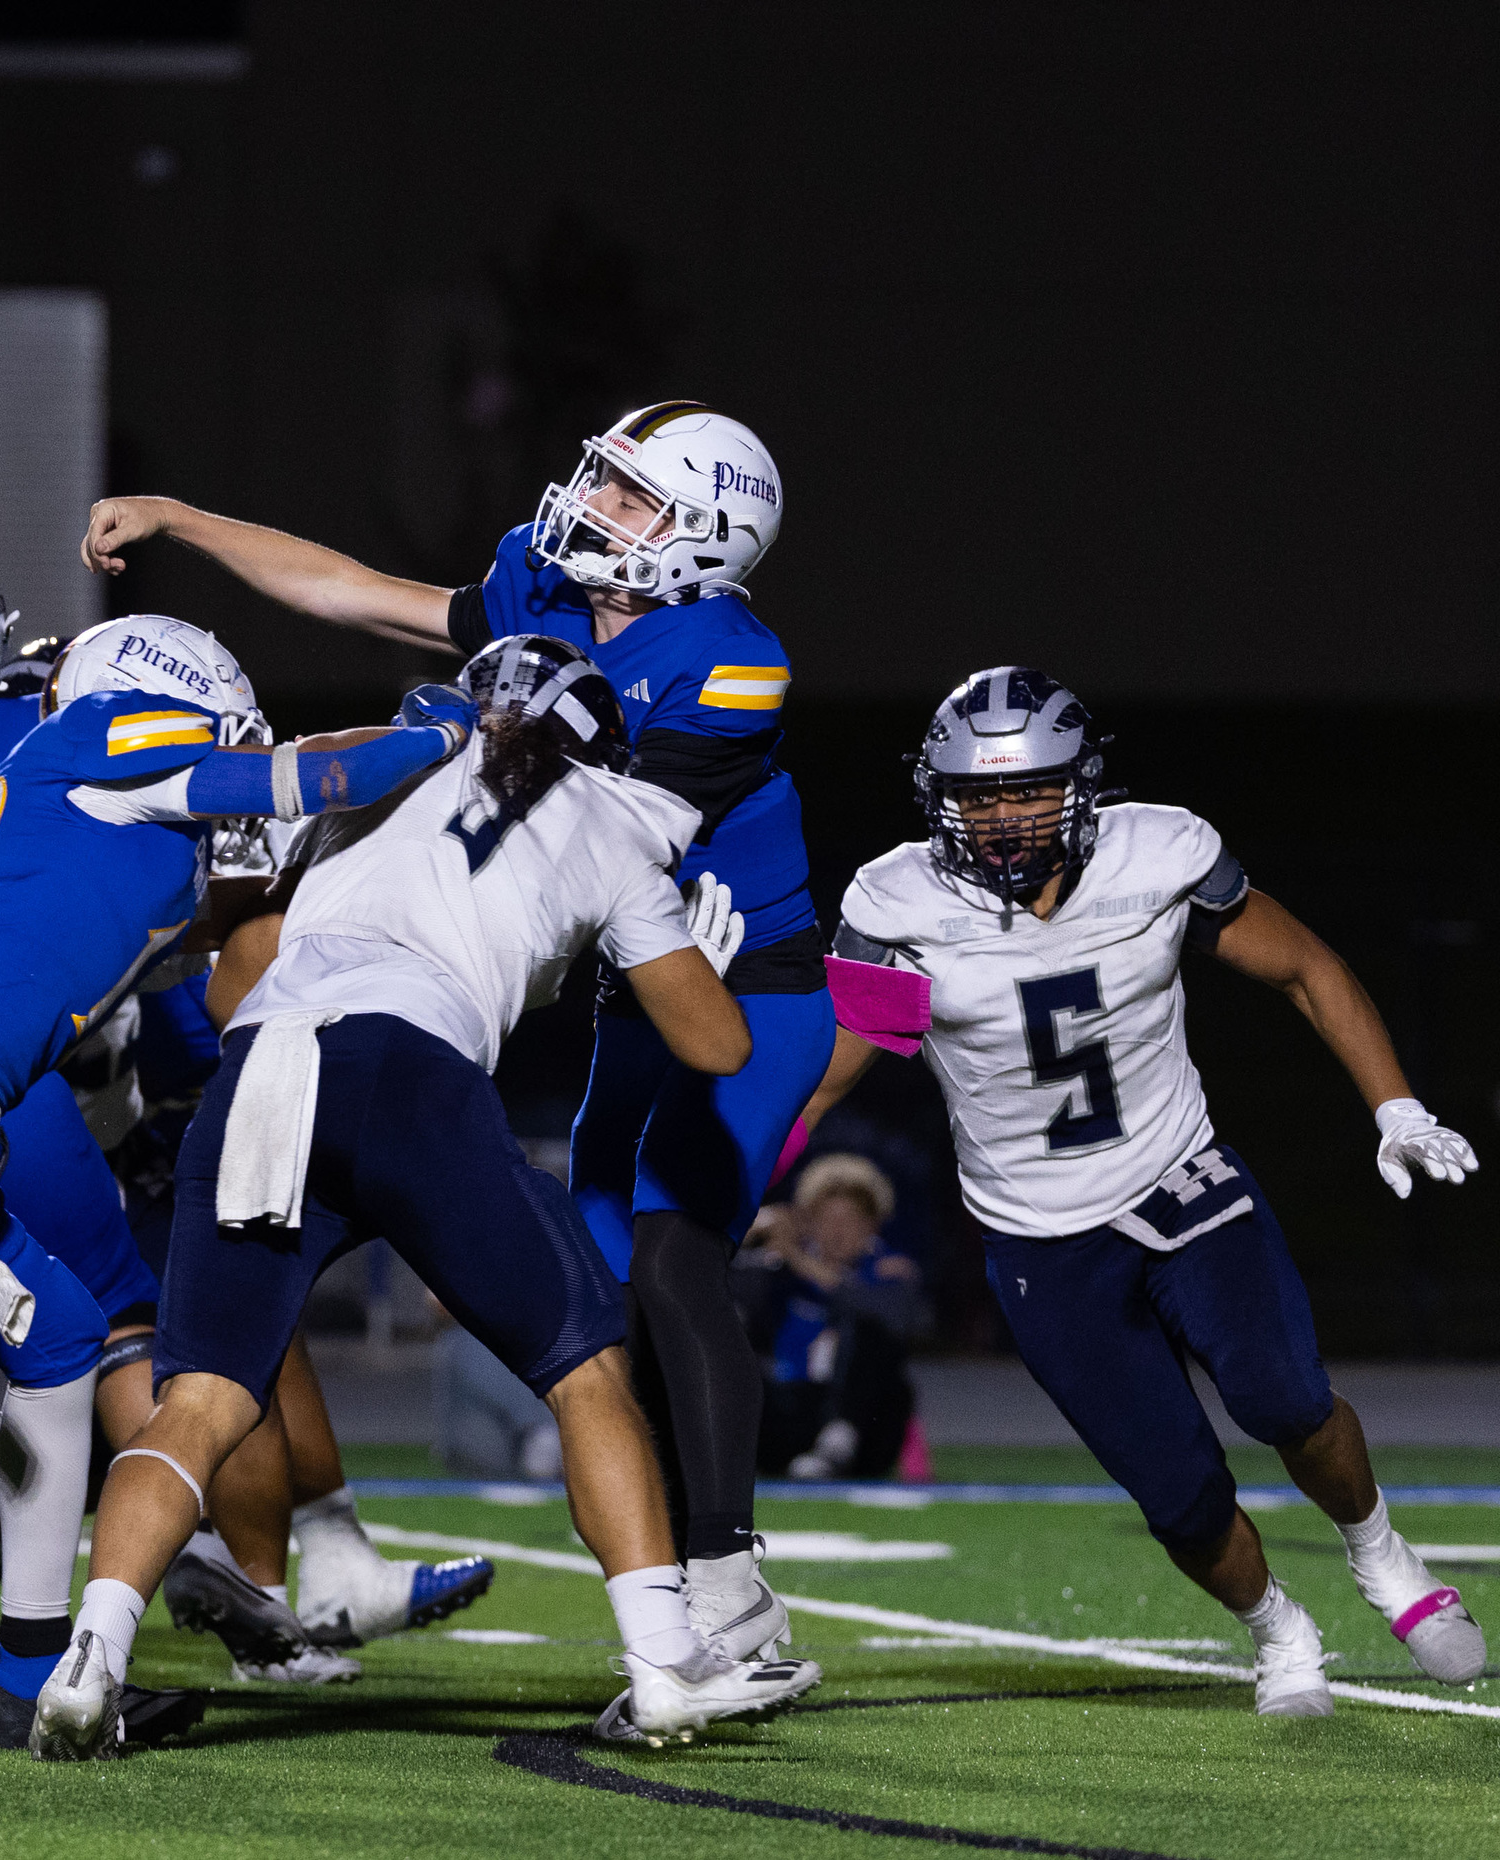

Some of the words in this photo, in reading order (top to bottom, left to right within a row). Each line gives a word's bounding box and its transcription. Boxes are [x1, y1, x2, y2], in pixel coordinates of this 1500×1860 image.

[713, 461, 776, 505] Pirates
[649, 531, 674, 546] dell
[116, 634, 213, 695] Pirates
[1013, 961, 1130, 1156] 5
[1159, 1148, 1240, 1206] H
